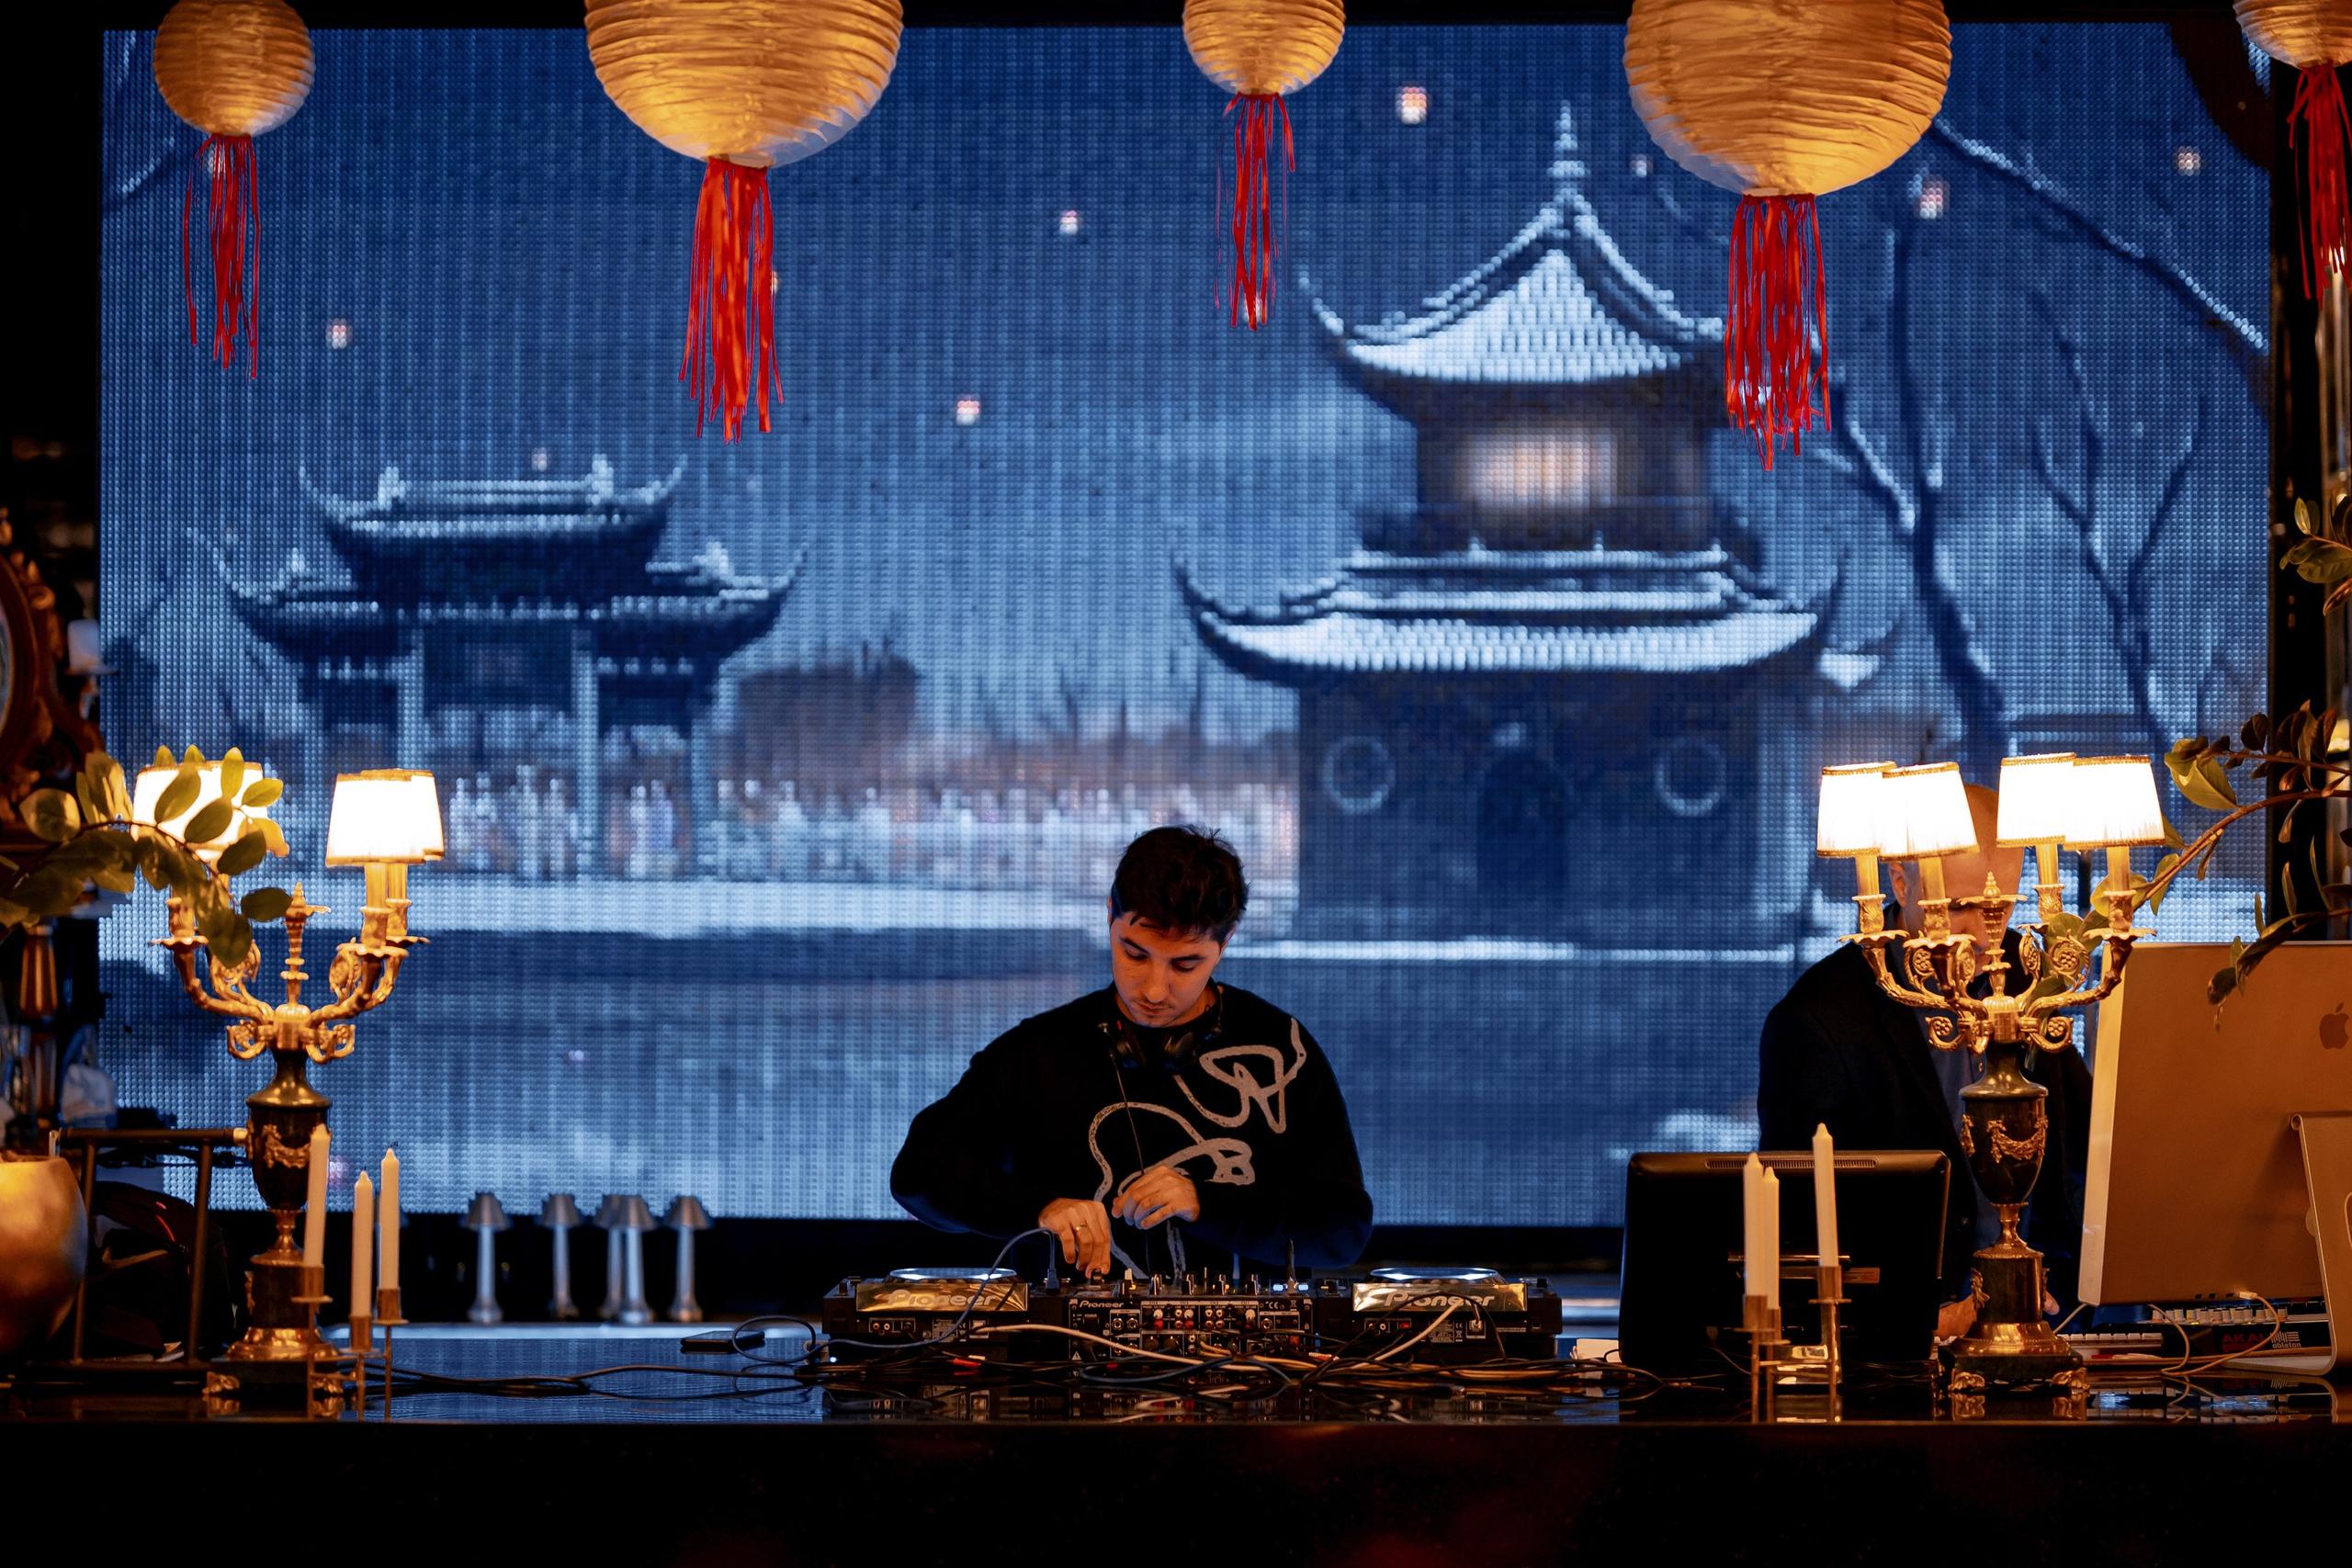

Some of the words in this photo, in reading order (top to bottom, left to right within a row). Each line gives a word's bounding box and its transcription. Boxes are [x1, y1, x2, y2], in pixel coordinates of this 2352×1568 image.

[888, 1289, 996, 1306] Pioneer
[1080, 1300, 1124, 1308] Pioneer
[2222, 1333, 2266, 1342] AKAI
